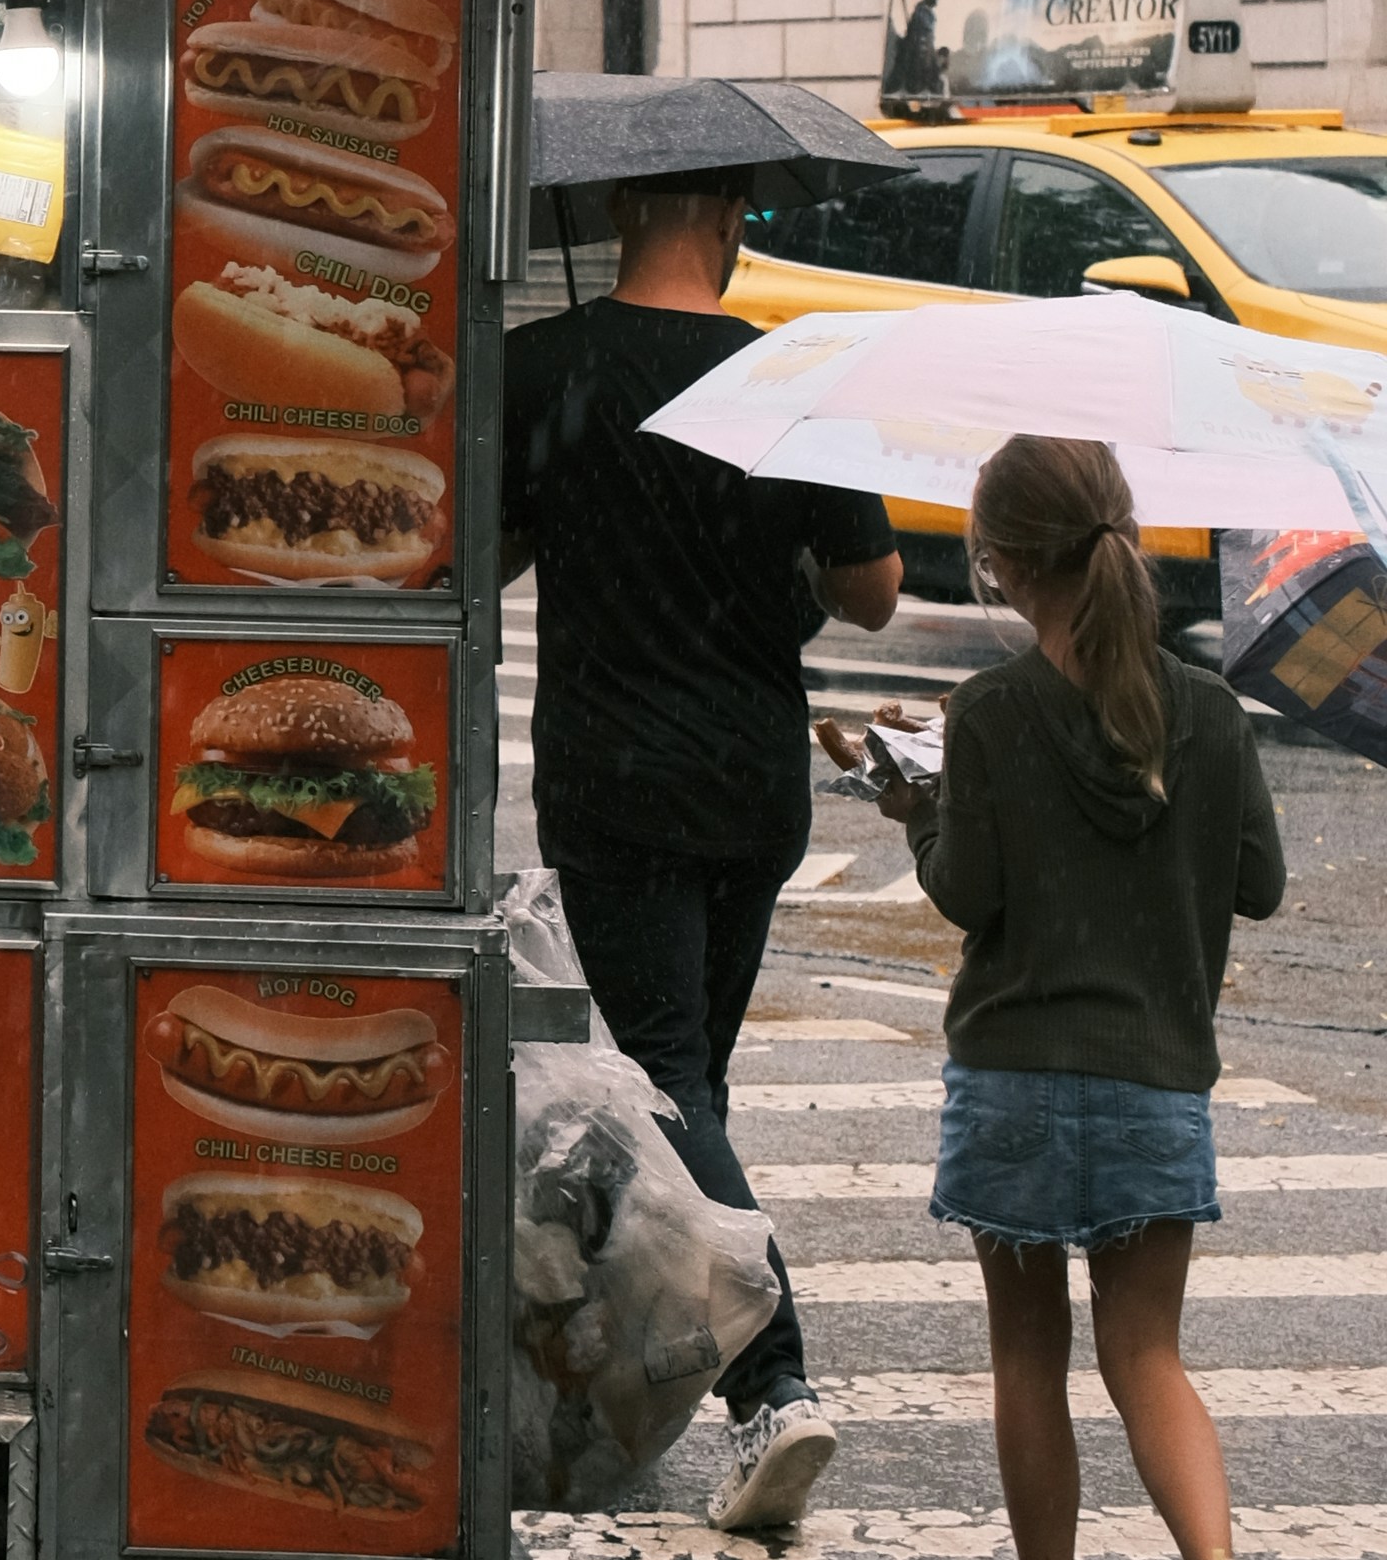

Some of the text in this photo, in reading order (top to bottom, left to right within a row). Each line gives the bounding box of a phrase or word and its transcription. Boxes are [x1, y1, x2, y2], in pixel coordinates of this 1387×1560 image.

[267, 114, 400, 165] HOT SAUSAGE
[294, 249, 433, 316] CHILI DOG
[223, 400, 420, 436] CHILI CHEESE DOG
[222, 656, 383, 703] CHEESEBURGER
[259, 976, 356, 1008] HOT DOG
[194, 1137, 397, 1174] CHILI CHEESE DOG
[230, 1345, 391, 1405] ITALIAN SAUSAGE
